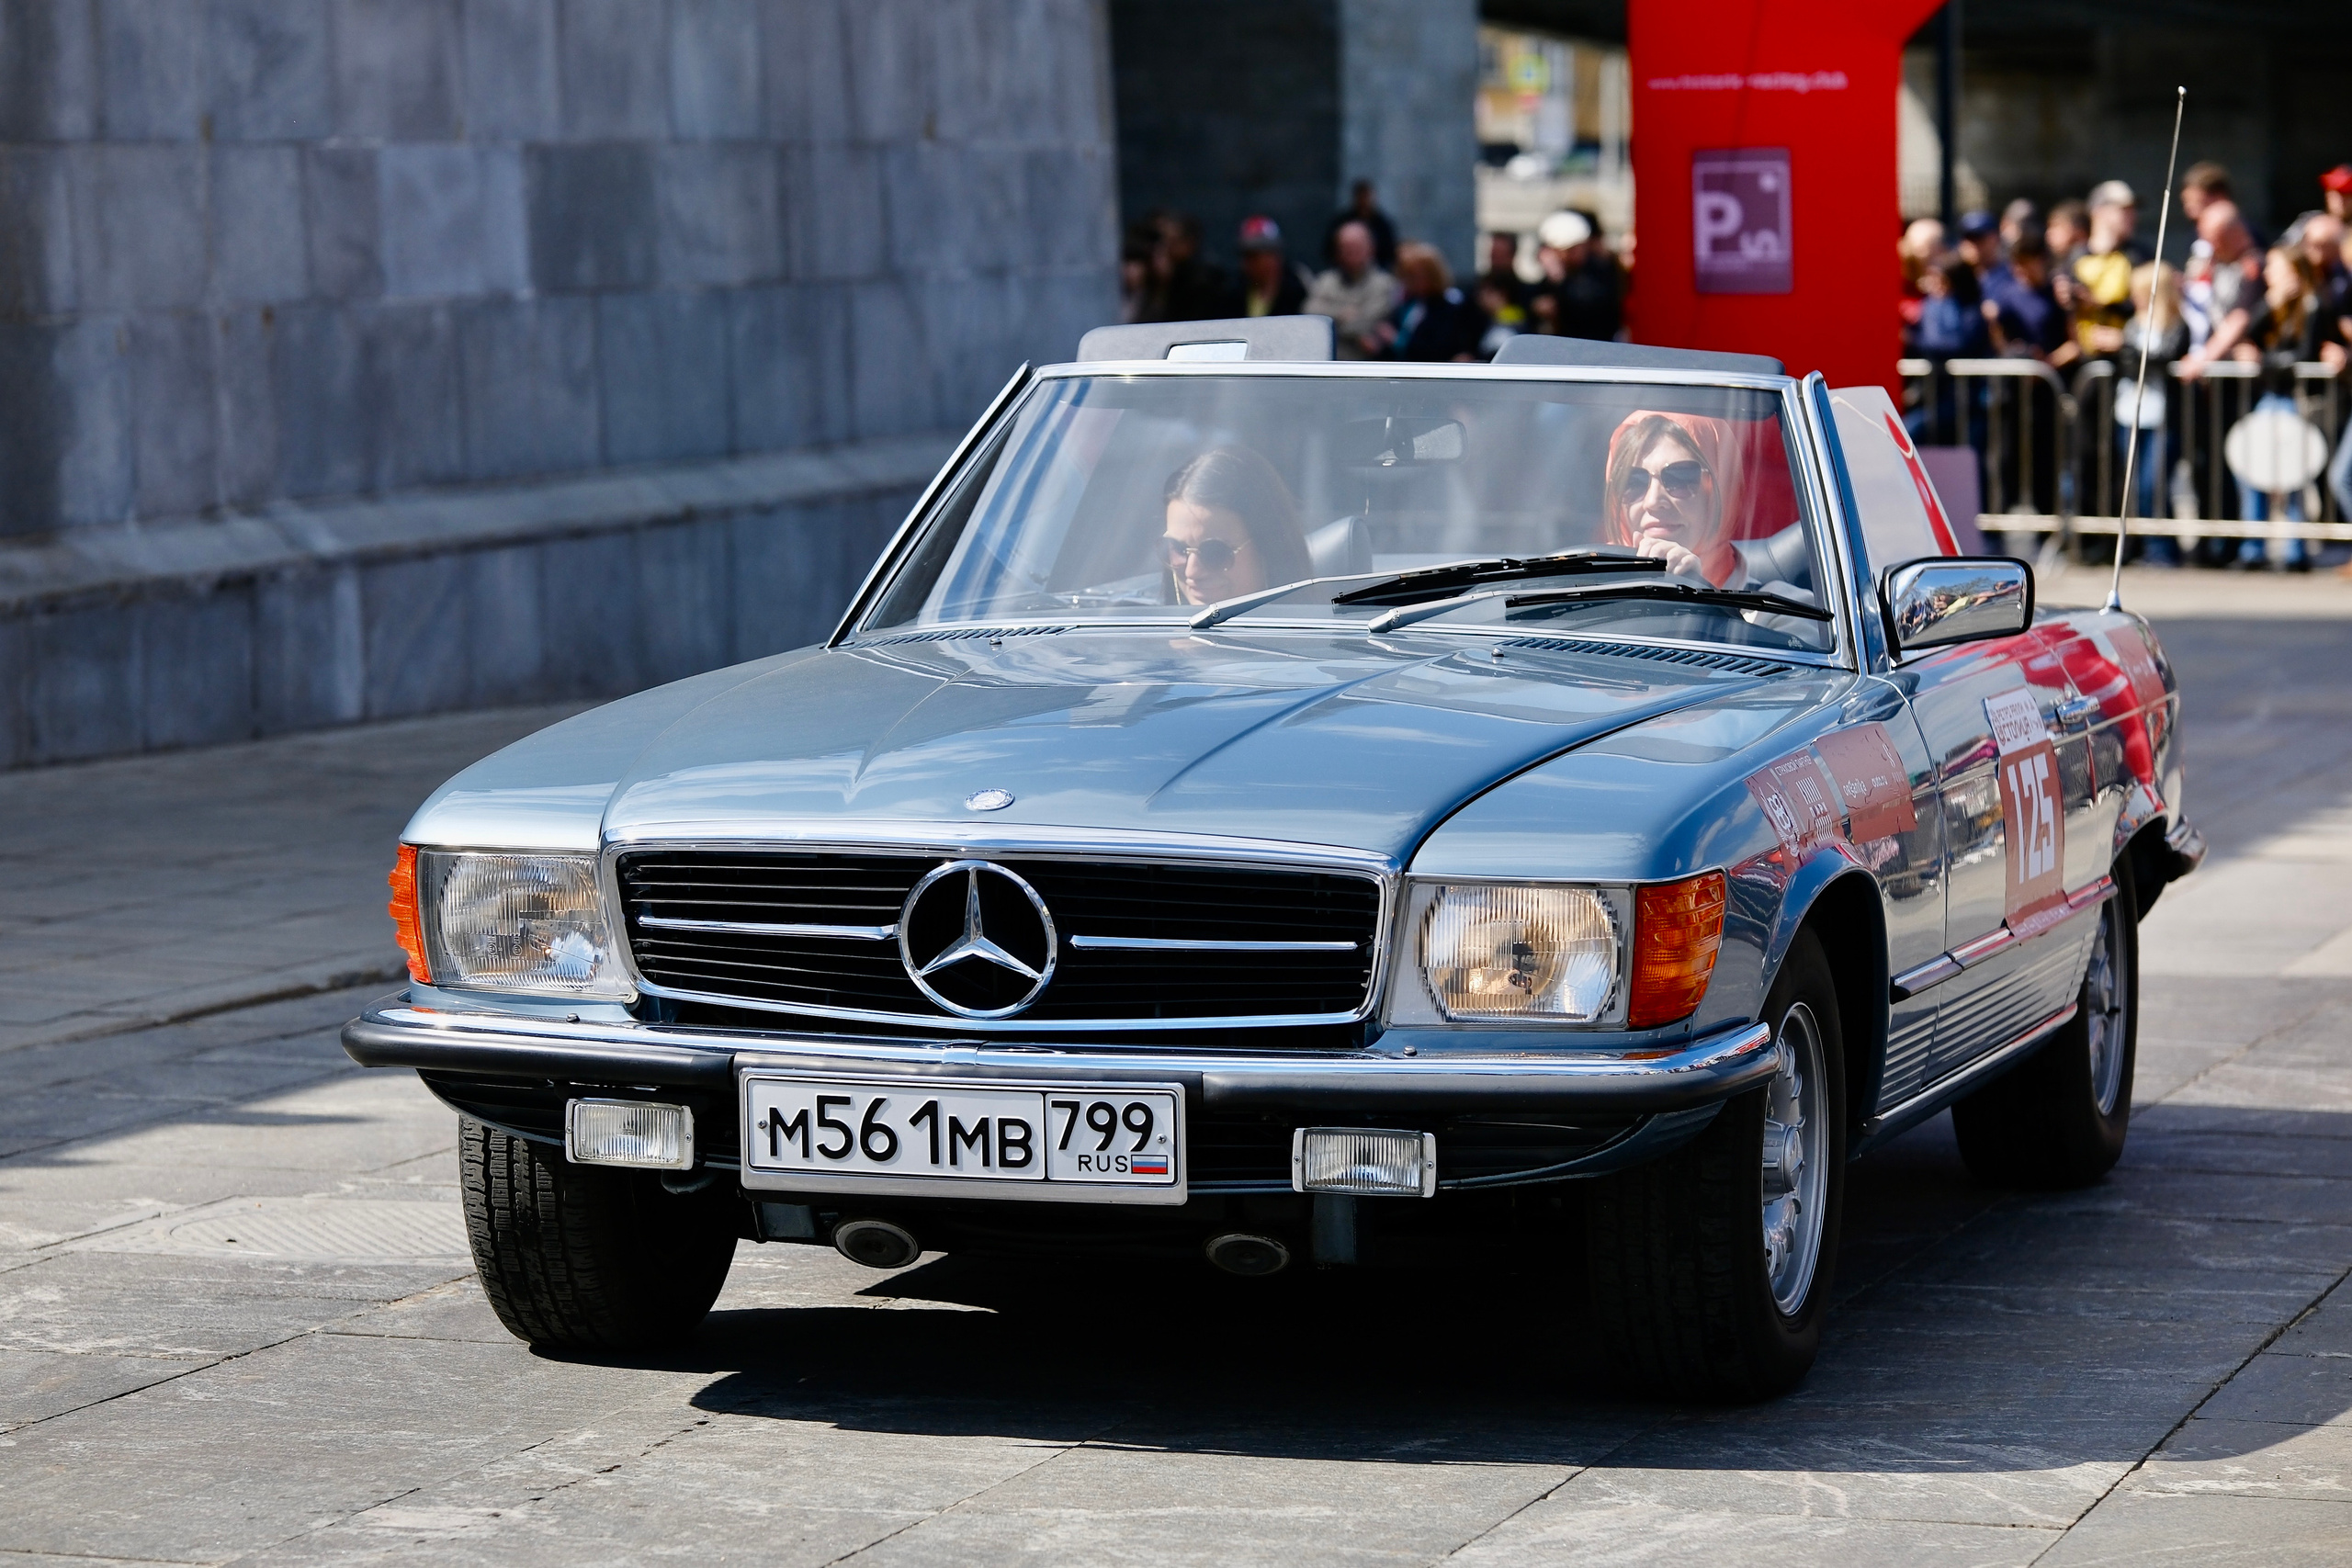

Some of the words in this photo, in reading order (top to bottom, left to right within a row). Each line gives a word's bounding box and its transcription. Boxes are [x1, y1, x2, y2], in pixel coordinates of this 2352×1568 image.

[2007, 752, 2055, 885] 125
[1050, 1100, 1155, 1152] 799
[1078, 1154, 1128, 1173] RUS
